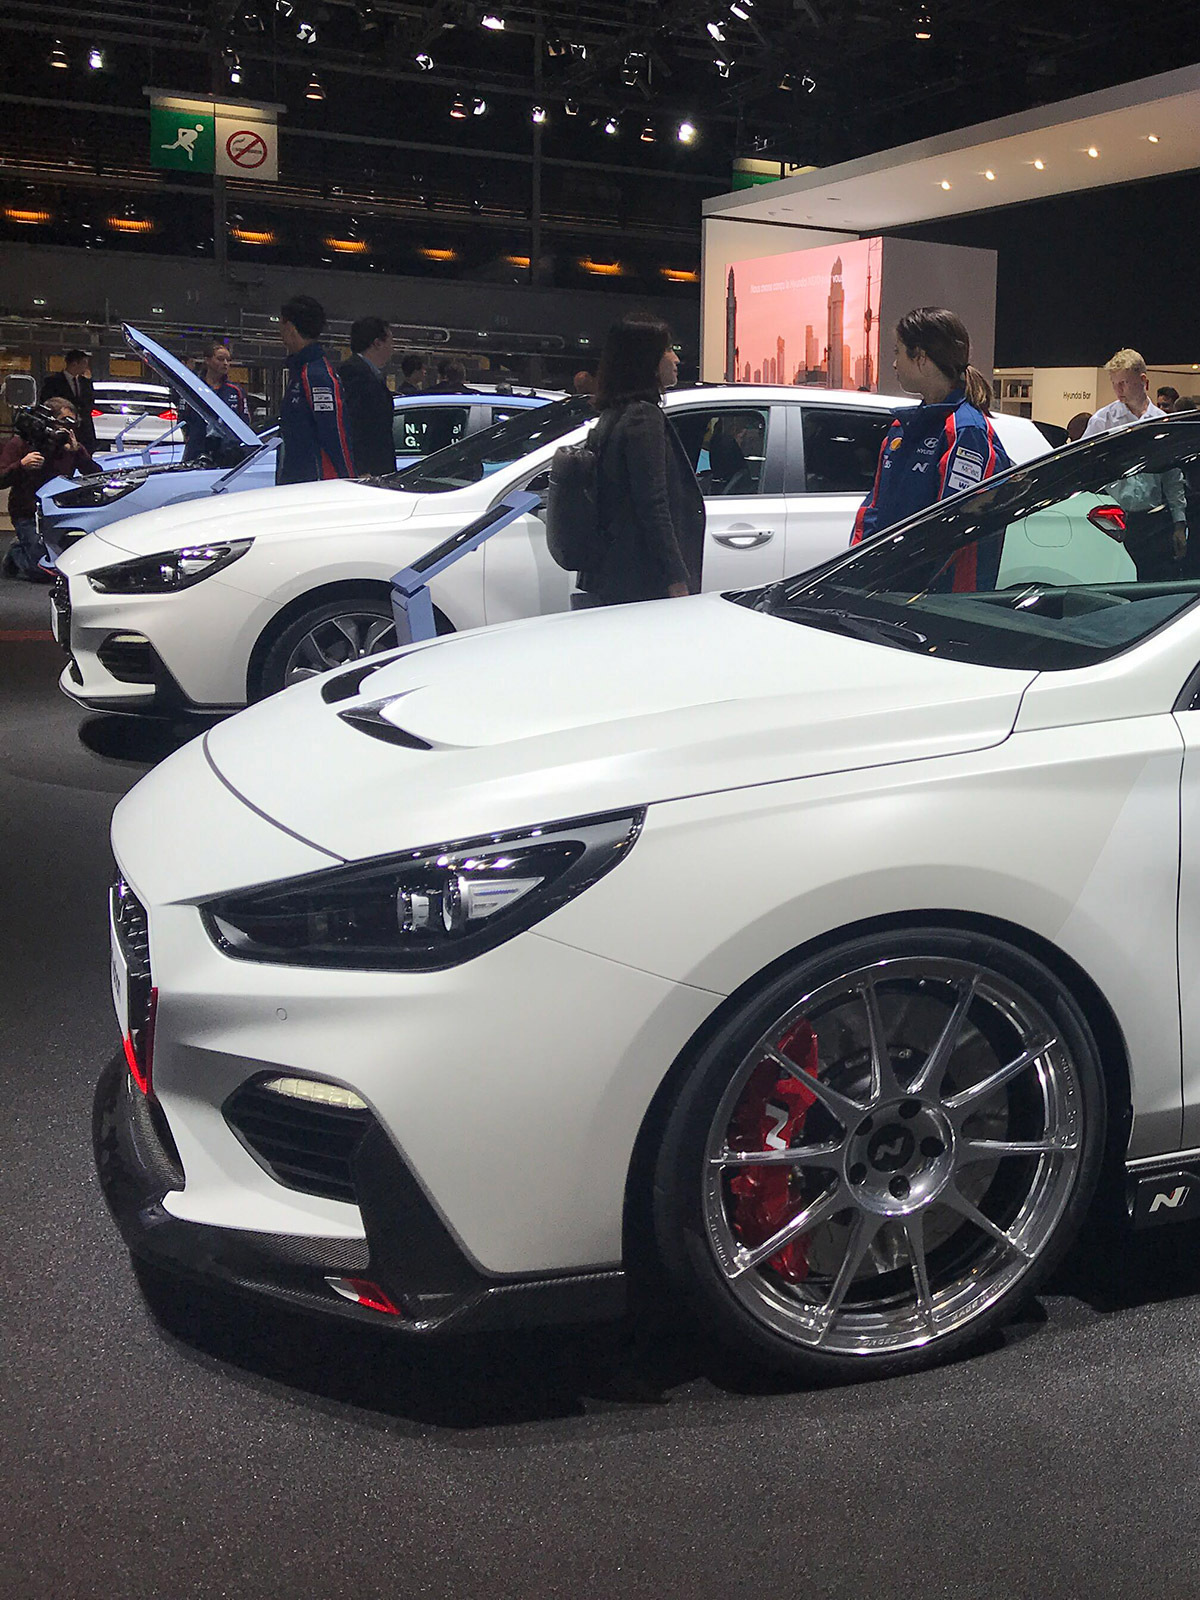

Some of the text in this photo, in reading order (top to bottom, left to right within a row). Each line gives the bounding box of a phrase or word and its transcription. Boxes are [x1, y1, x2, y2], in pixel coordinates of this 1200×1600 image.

[1063, 391, 1091, 401] Hyundai Bar
[1149, 1186, 1190, 1212] N
